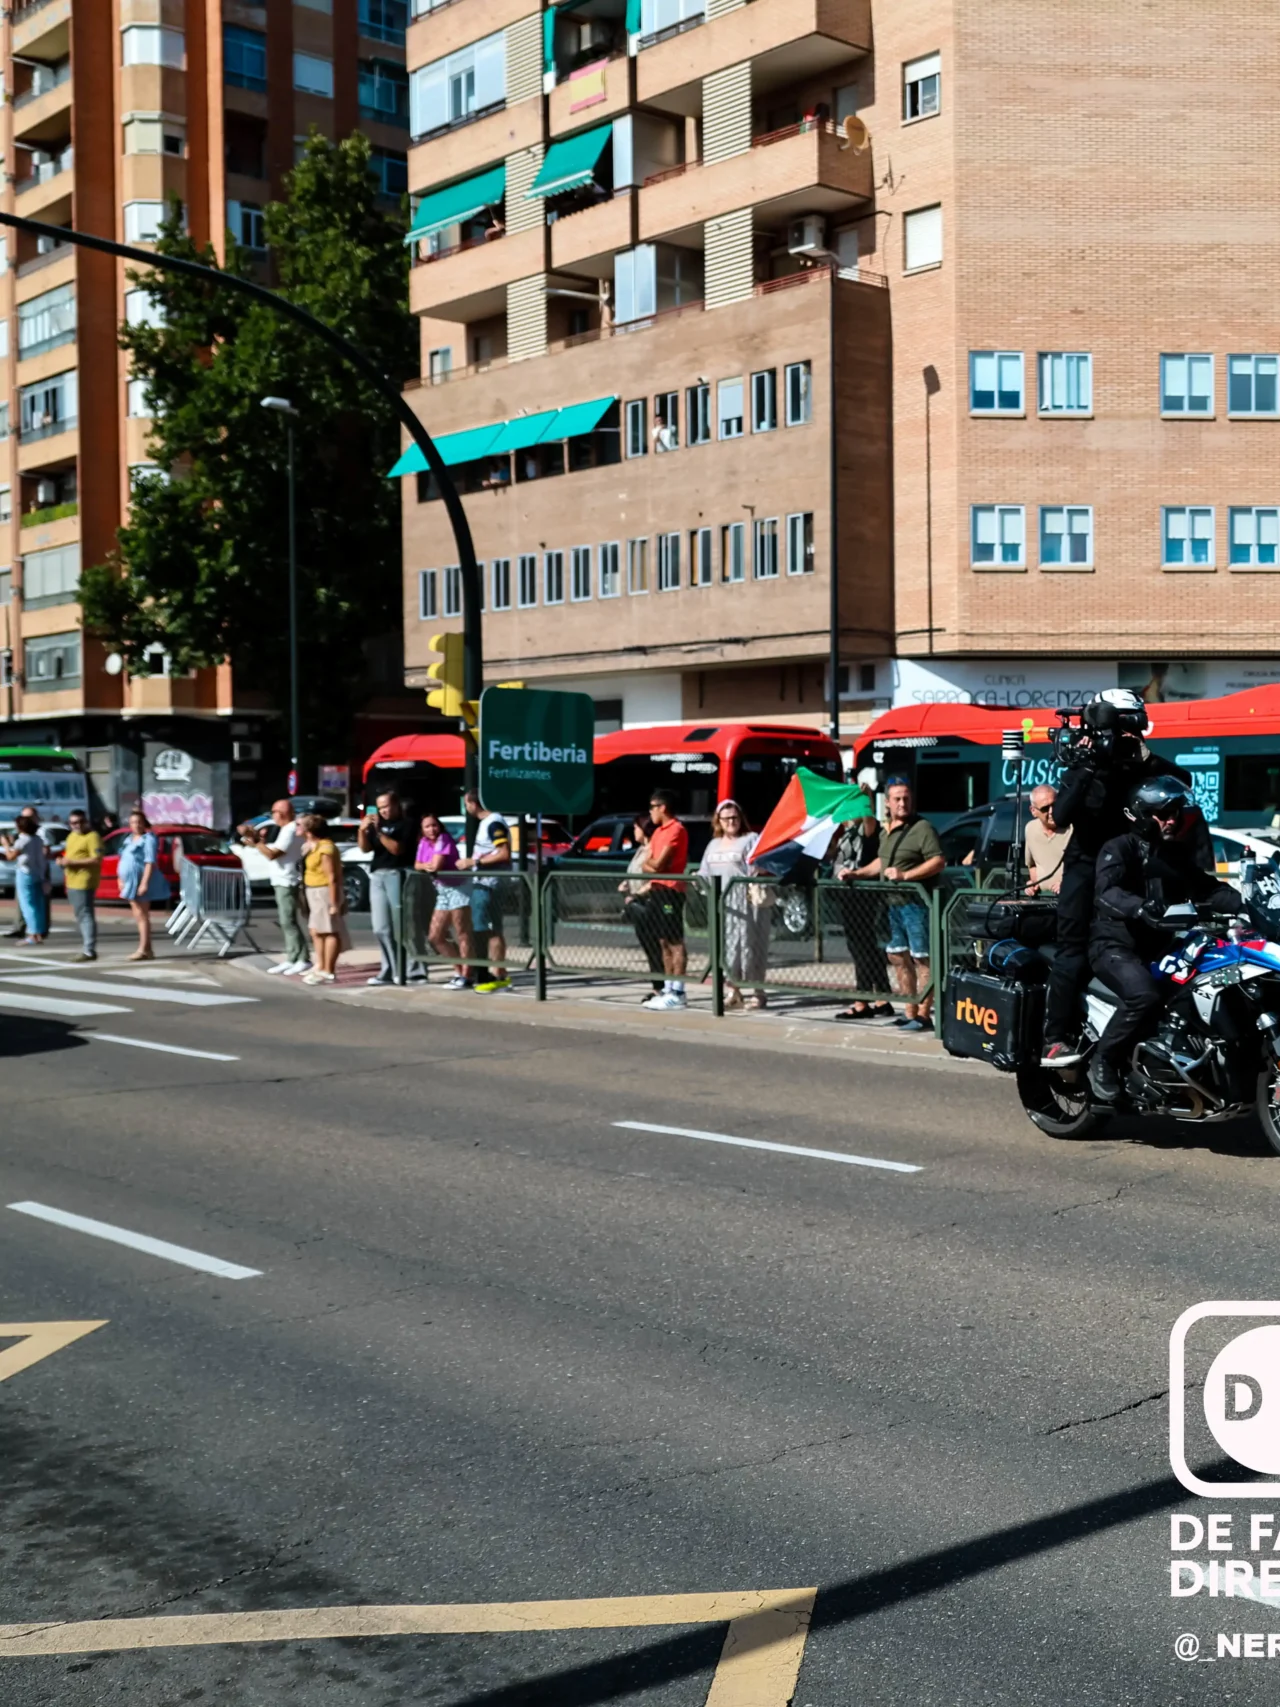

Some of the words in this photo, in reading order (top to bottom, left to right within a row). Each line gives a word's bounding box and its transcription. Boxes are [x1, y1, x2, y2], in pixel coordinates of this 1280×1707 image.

[488, 740, 587, 763] Fertiberia
[488, 766, 551, 780] Fertilizantes
[956, 997, 998, 1035] rtve
